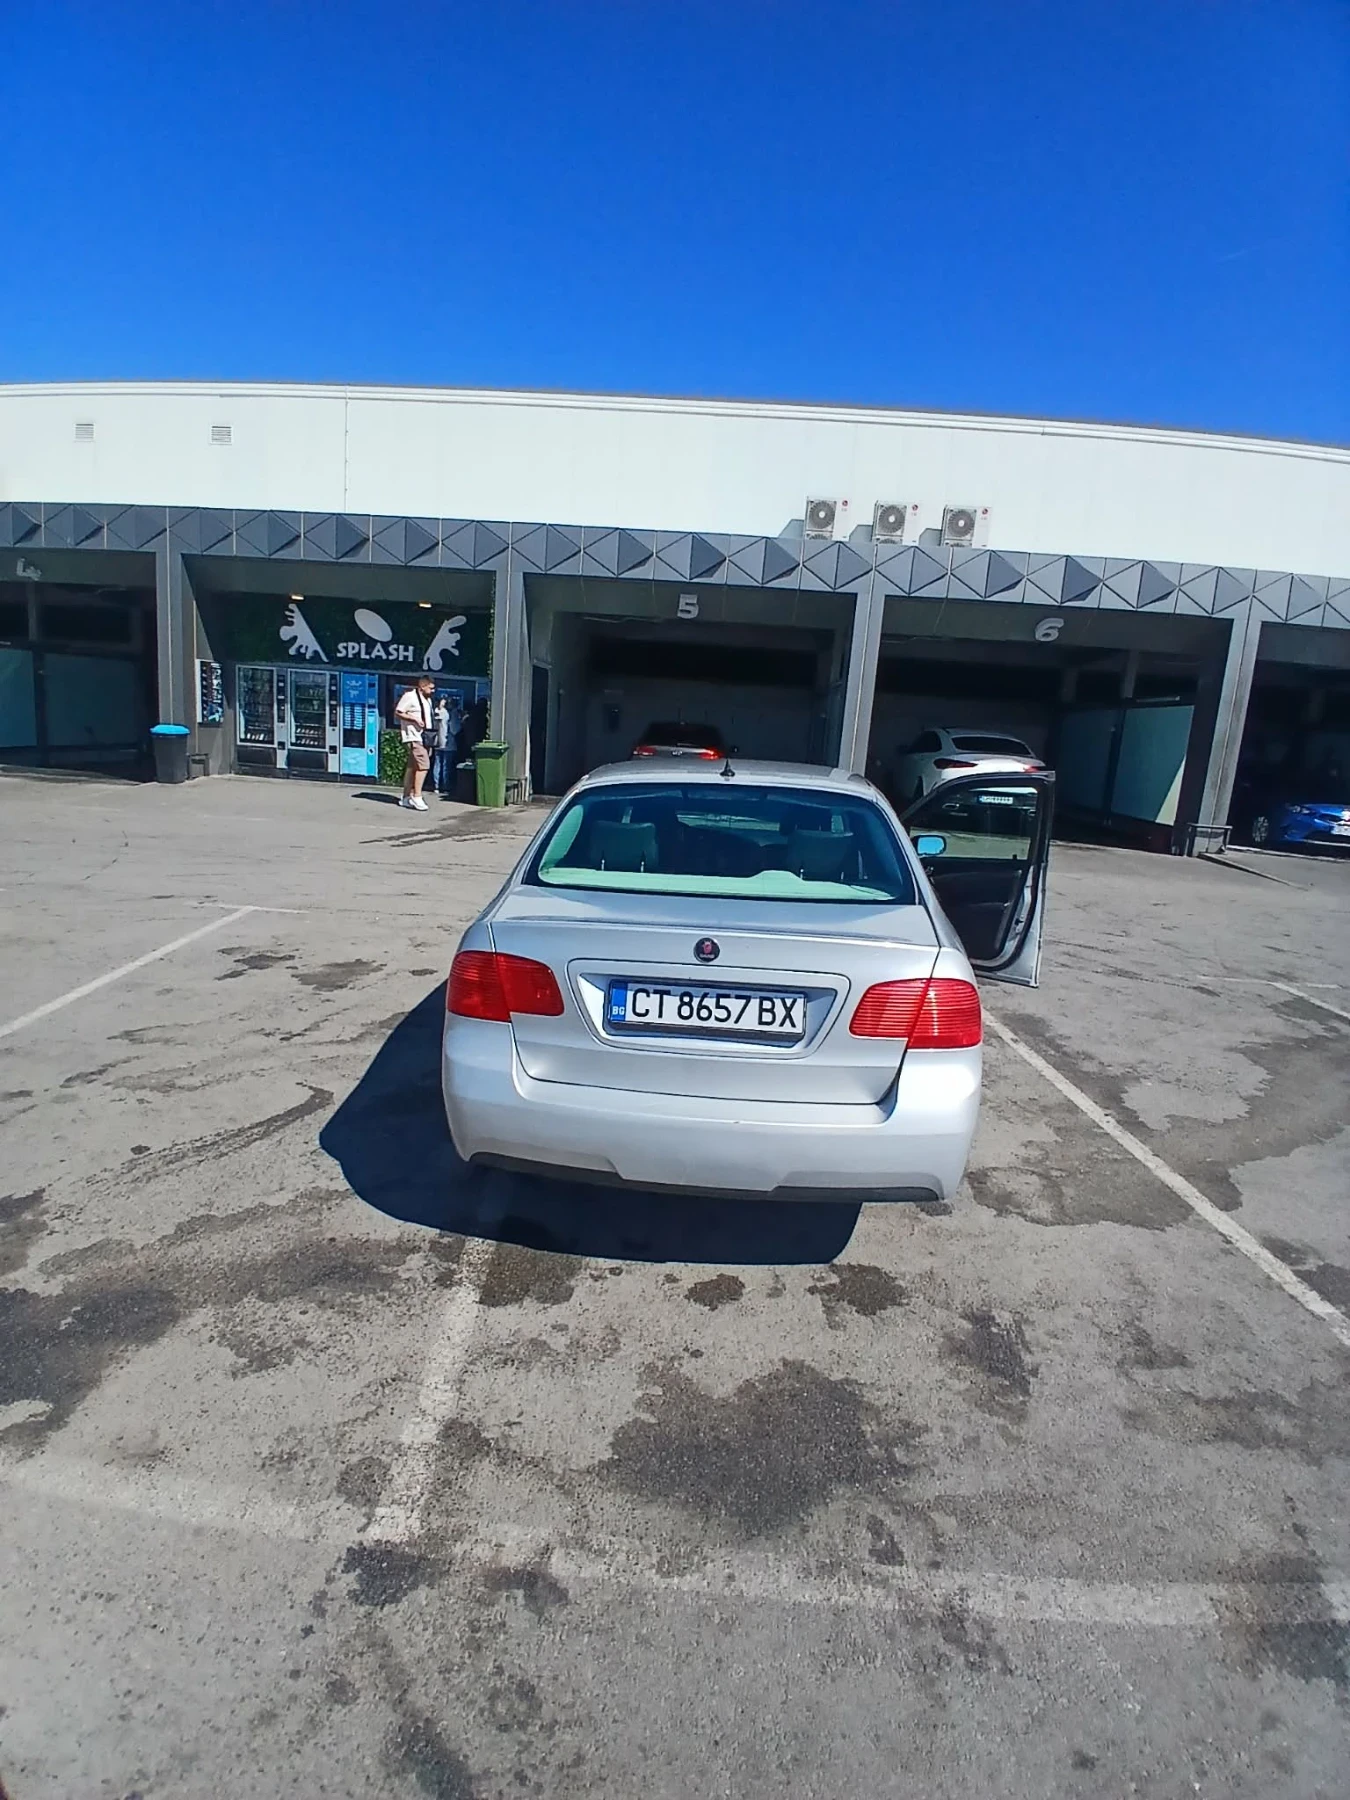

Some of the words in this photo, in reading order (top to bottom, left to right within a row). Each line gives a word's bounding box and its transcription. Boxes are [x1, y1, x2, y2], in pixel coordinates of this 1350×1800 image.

[676, 593, 699, 620] 5
[1034, 617, 1065, 642] 6
[336, 641, 414, 662] SPLASH
[612, 1006, 626, 1015] BG
[631, 988, 672, 1019] CT
[677, 991, 752, 1024] 8657
[757, 996, 798, 1028] BX
